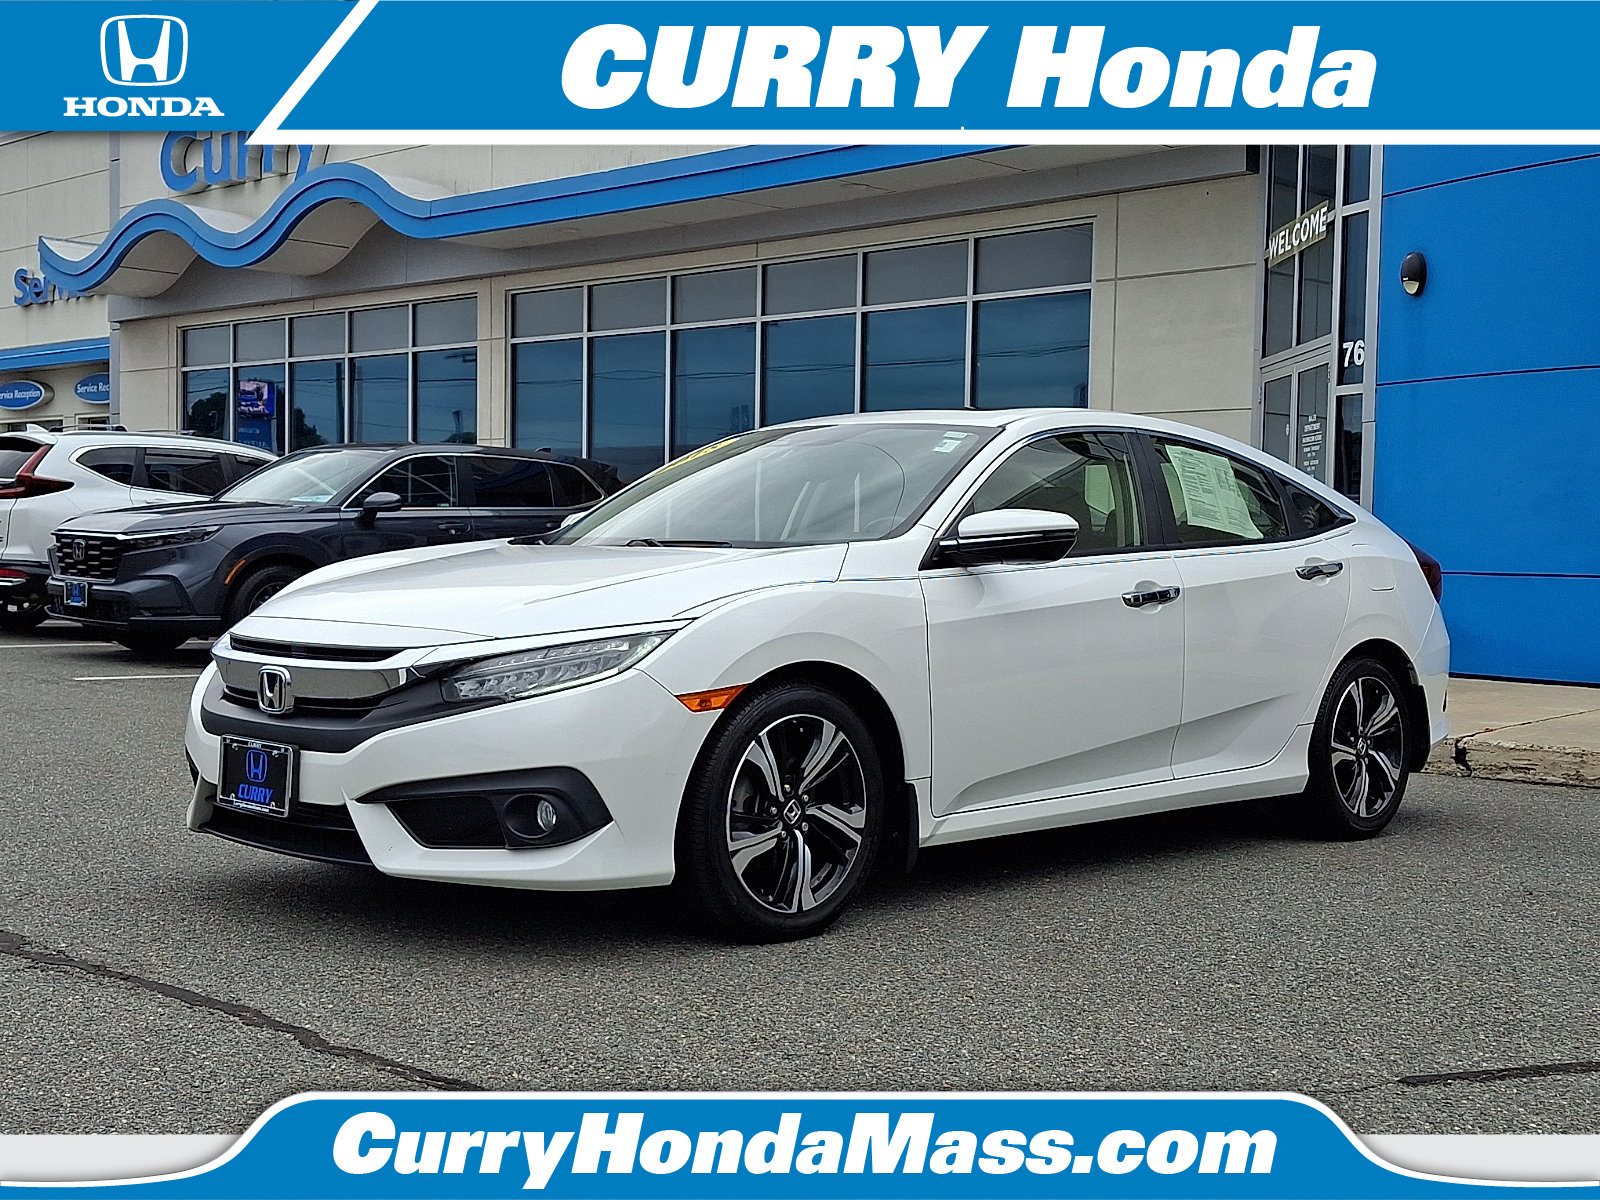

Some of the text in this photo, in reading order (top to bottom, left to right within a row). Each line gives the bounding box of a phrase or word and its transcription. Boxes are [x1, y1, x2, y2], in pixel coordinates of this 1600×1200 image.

[1268, 206, 1328, 260] WELCOME
[1342, 339, 1365, 368] 76
[0, 388, 41, 400] ervice Reception
[77, 382, 97, 393] Service
[238, 784, 273, 804] CURRY
